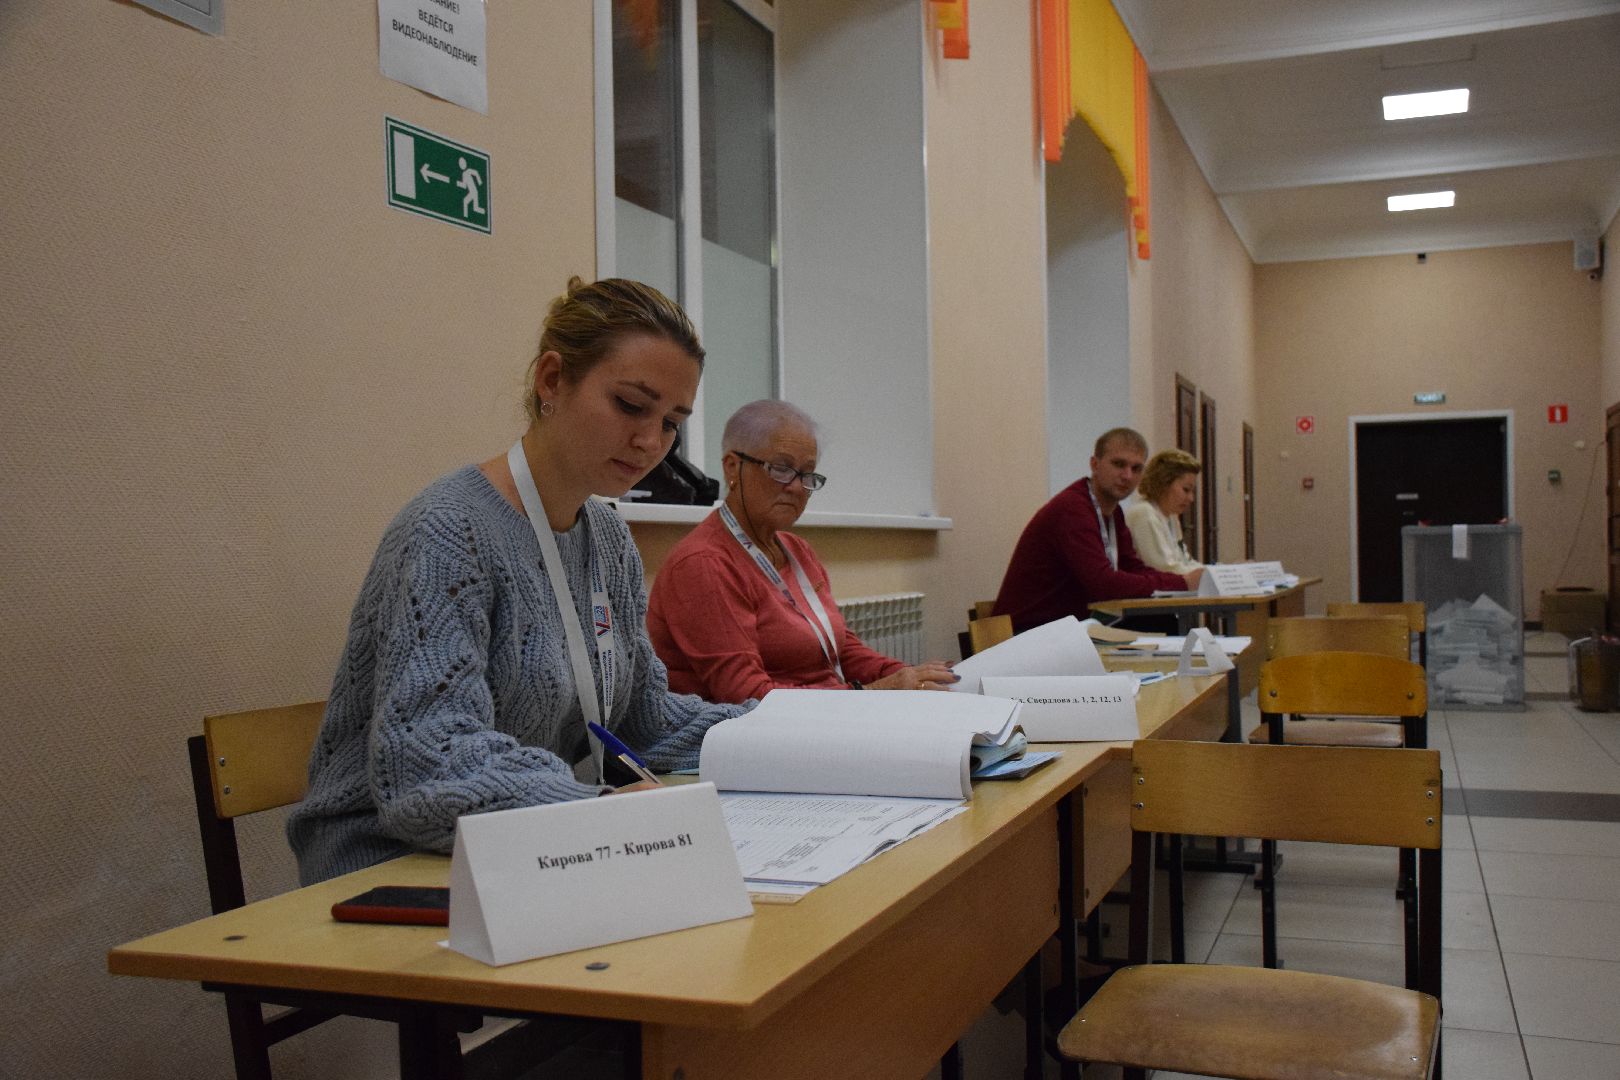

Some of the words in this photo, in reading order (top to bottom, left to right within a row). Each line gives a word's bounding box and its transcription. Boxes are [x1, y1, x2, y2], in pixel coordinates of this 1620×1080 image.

[418, 9, 454, 34] ВЕДЁТСЯ
[391, 19, 478, 67] ВИДЕОНАБЛЮДЕНИЕ
[1026, 696, 1071, 705] Свердлова
[537, 851, 594, 870] Кирова
[595, 846, 611, 860] 77
[623, 838, 676, 857] Кирова
[677, 833, 693, 846] 81
